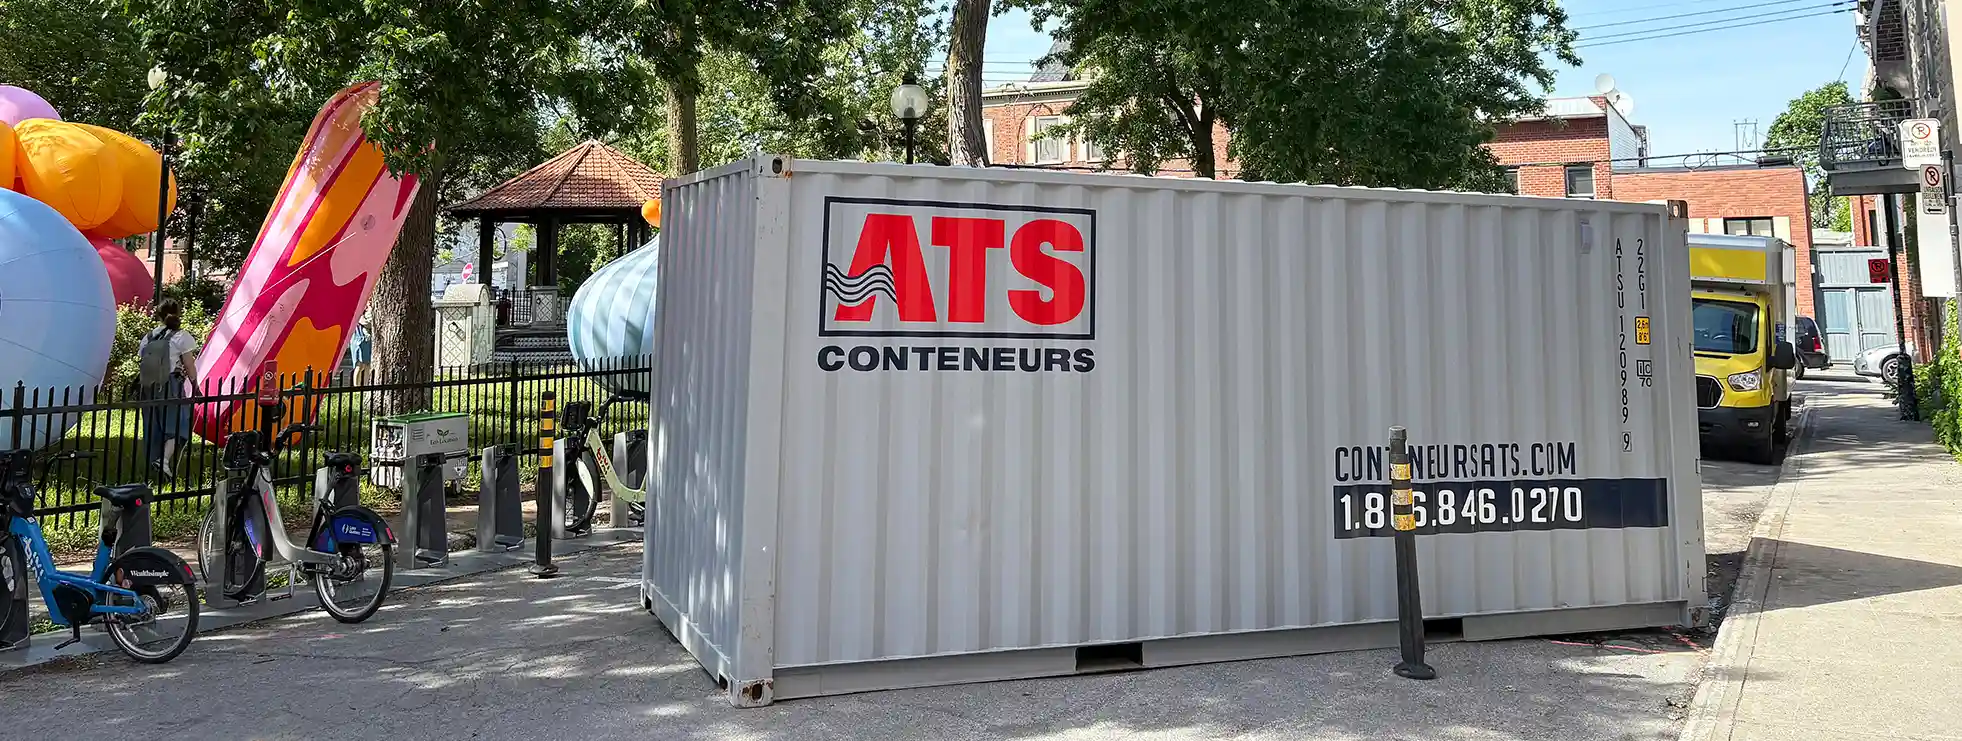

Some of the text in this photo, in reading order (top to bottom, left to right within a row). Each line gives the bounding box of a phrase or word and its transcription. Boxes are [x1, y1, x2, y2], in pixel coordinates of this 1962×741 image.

[834, 213, 1085, 325] ATS
[1615, 238, 1625, 309] ATSU
[1637, 238, 1645, 310] 22G1
[817, 345, 1096, 373] CONTENEURS
[1619, 315, 1629, 424] 120989
[1639, 377, 1652, 388] 70
[1335, 442, 1576, 482] CONNEURSATS.COM
[1340, 487, 1583, 531] 1.86.846.0270
[130, 569, 169, 578] Wealthsimple
